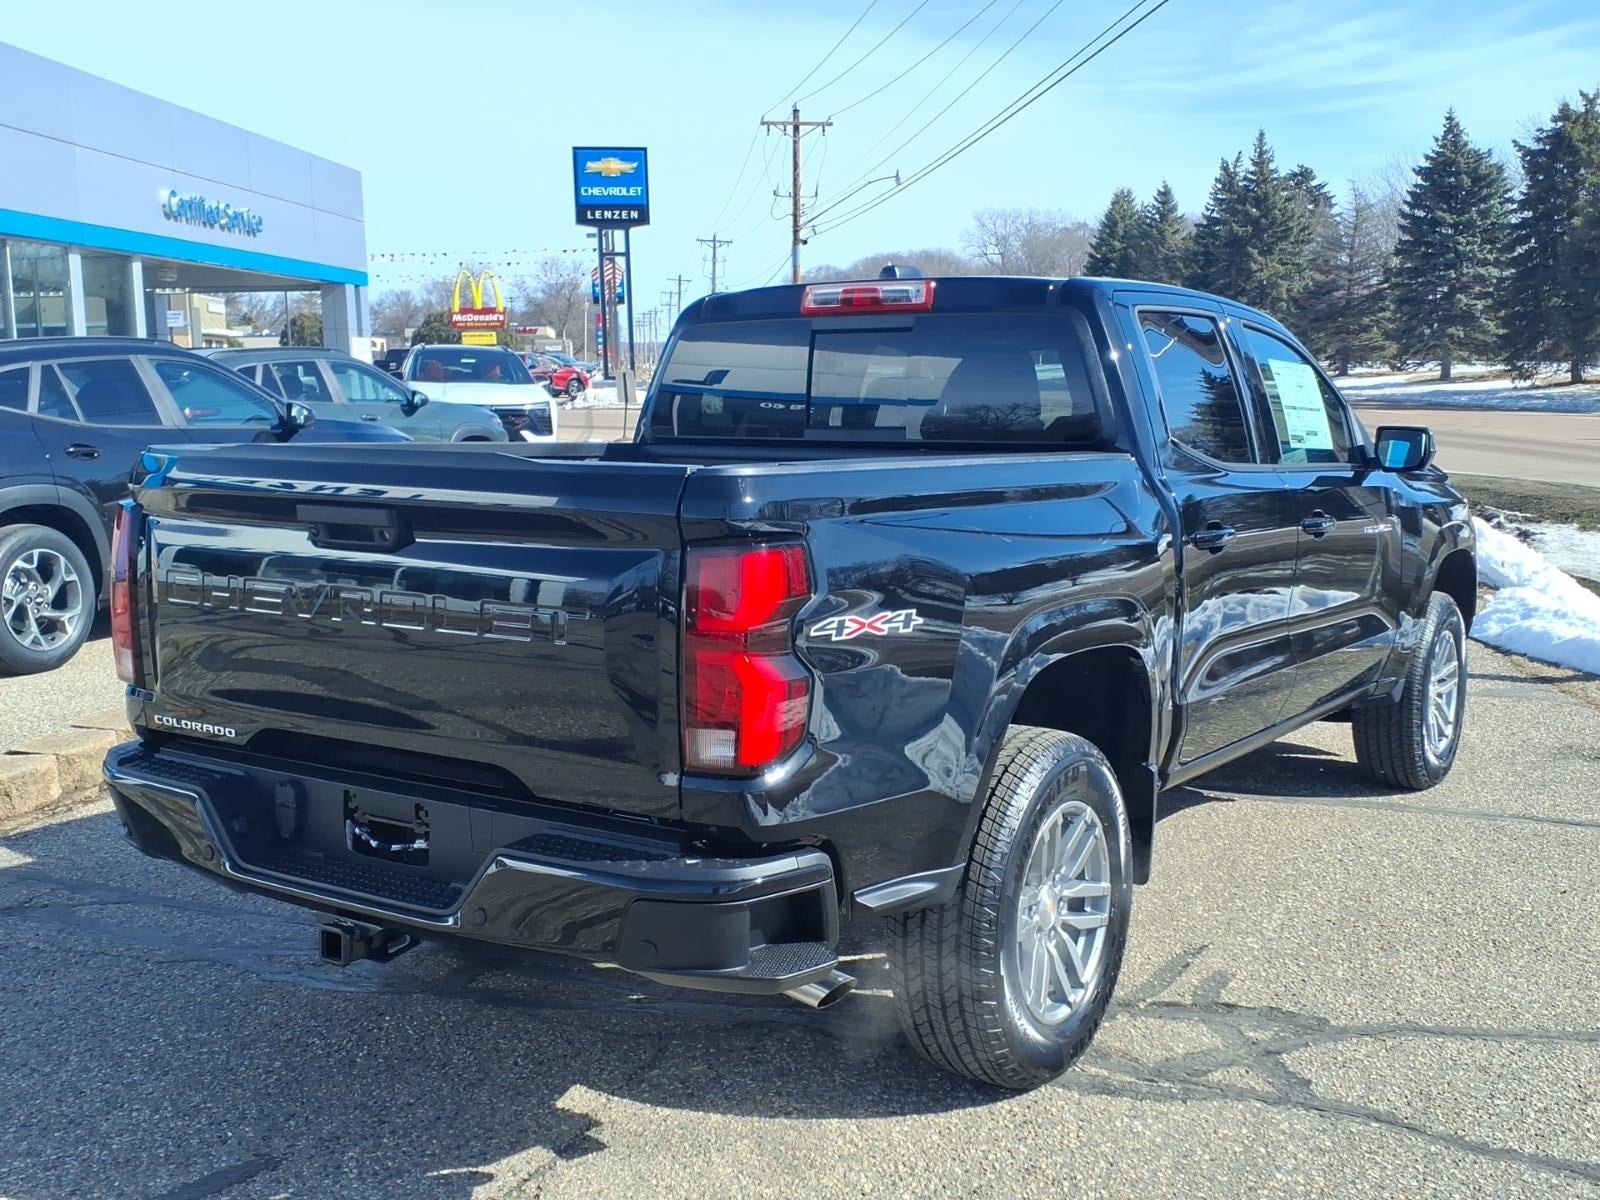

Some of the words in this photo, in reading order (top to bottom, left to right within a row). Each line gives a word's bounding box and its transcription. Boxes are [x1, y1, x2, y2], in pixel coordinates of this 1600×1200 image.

[581, 186, 643, 196] CHEVROLET
[165, 189, 220, 226] Certified
[222, 203, 263, 235] Service
[587, 210, 639, 219] LENZEN
[452, 313, 504, 322] McDonald's
[165, 569, 591, 646] CHEVROLET
[154, 714, 236, 738] COLORADO
